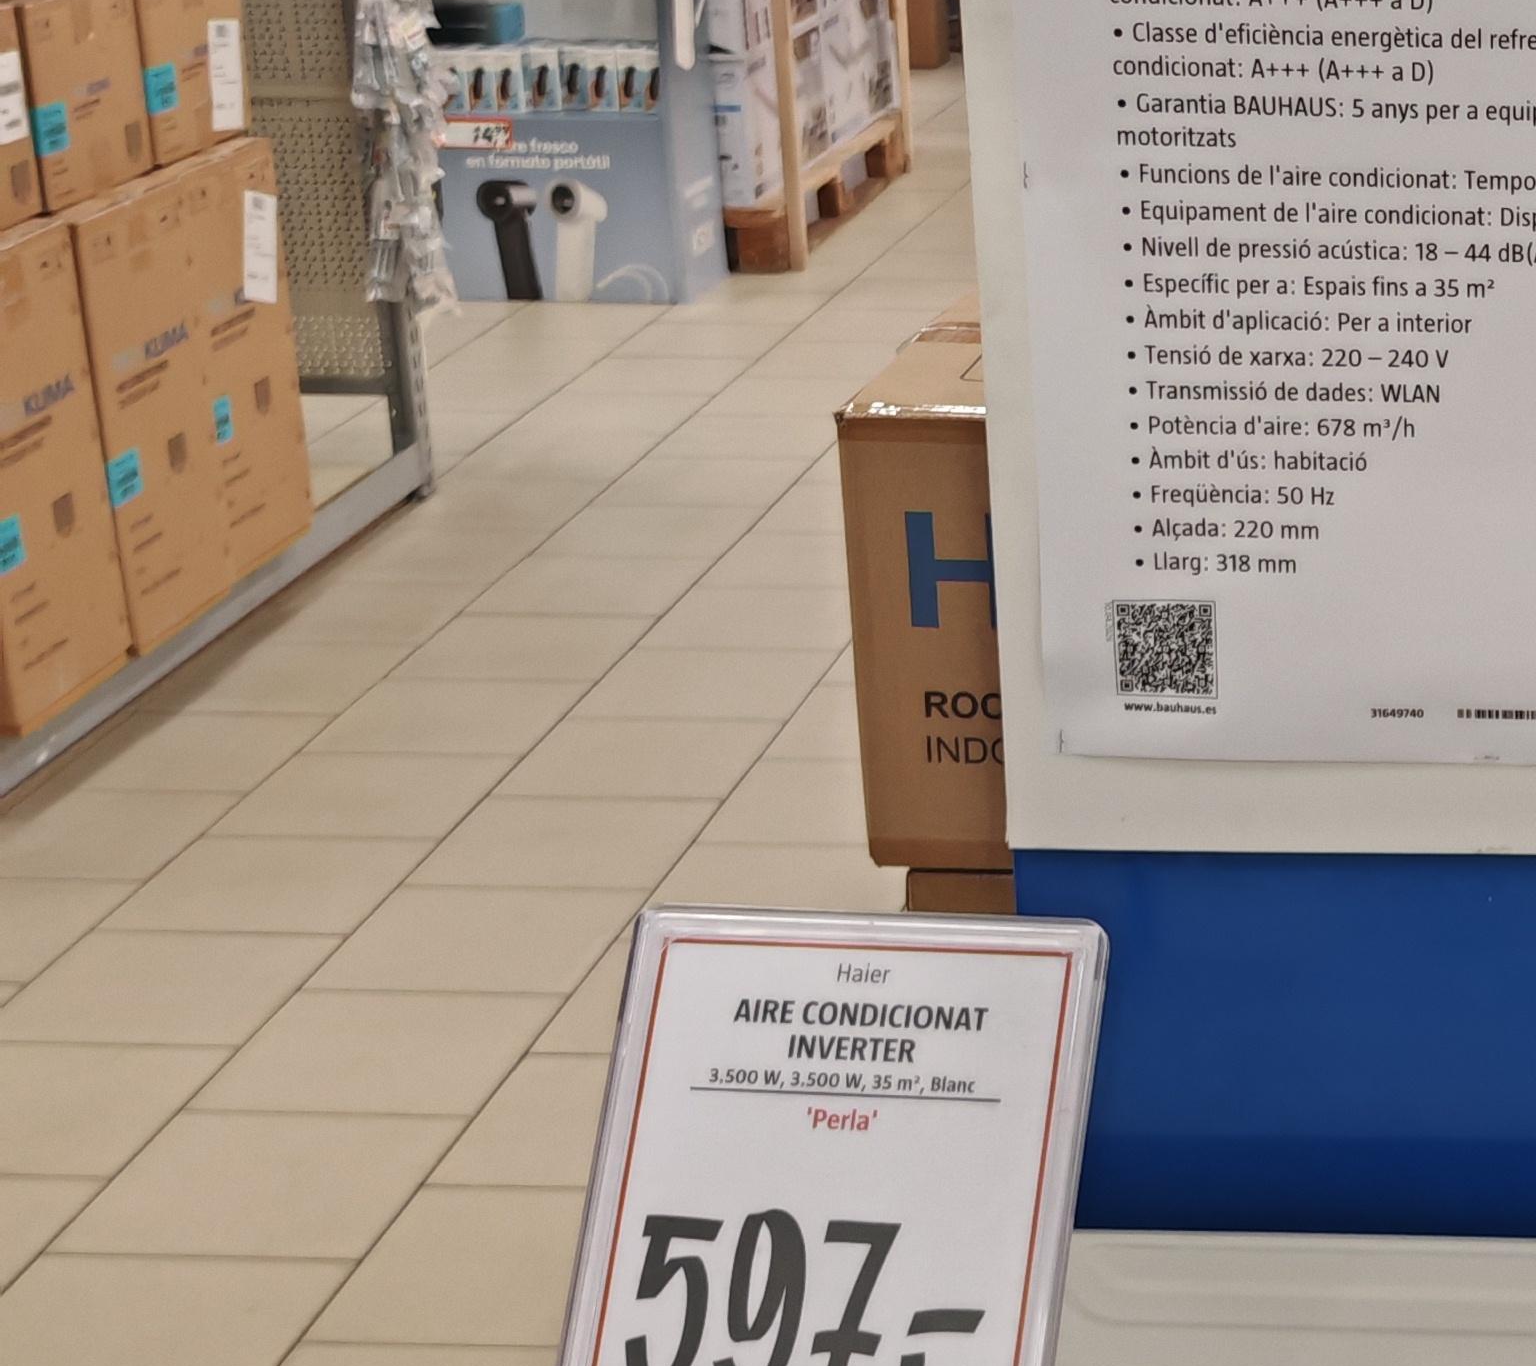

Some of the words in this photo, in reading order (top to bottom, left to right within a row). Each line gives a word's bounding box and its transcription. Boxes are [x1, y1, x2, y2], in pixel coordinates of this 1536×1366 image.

[1132, 20, 1198, 44] Classe
[1204, 21, 1324, 47] d'eficiència
[1330, 25, 1444, 53] energètica
[1450, 27, 1482, 50] del
[1136, 92, 1226, 115] Garantia
[1233, 94, 1344, 118] BAUHAUS:
[1351, 98, 1365, 119] 5
[1371, 102, 1419, 125] anys
[1425, 103, 1461, 125] per
[1466, 104, 1479, 121] a
[1116, 125, 1237, 149] motoritzats
[1139, 162, 1231, 185] Funcions
[1237, 163, 1263, 186] de
[1269, 164, 1322, 187] l'aire
[1328, 166, 1457, 190] condicionat:
[1141, 235, 1199, 258] Nivell
[1205, 236, 1231, 258] de
[1238, 238, 1312, 264] pressió
[1317, 238, 1408, 261] acústica:
[1414, 242, 1438, 262] 18
[1463, 243, 1492, 263] 44
[1144, 303, 1206, 330] Àmbit
[1212, 308, 1330, 336] d'aplicació:
[1337, 312, 1372, 332] Per
[1377, 316, 1390, 333] a
[1396, 311, 1473, 334] interior
[1145, 379, 1268, 401] Transmissió
[1274, 380, 1299, 402] de
[1305, 381, 1373, 403] dades:
[1380, 383, 1440, 404] WLAN
[1148, 414, 1237, 436] Potència
[1243, 415, 1310, 437] d'aire:
[1316, 418, 1356, 437] 678
[1148, 445, 1211, 470] Àmbit
[1216, 449, 1266, 470] d'ús:
[1273, 449, 1368, 472] habitació
[1150, 483, 1270, 508] Freqüència:
[1276, 485, 1304, 506] 50
[1310, 486, 1335, 506] Hz
[1151, 517, 1226, 542] Alçada:
[1234, 519, 1274, 539] 220
[1280, 524, 1320, 540] mm
[1153, 550, 1209, 576] Llarg:
[1216, 553, 1251, 573] 318
[1257, 557, 1297, 574] mm
[1123, 701, 1217, 715] www.bauhaus.es
[1370, 707, 1425, 719] 31649740
[836, 962, 891, 984] Haier
[733, 998, 796, 1025] AIRE
[802, 1000, 989, 1031] CONDICIONAT
[787, 1034, 916, 1063] INVERTER
[709, 1067, 758, 1085] 3.500
[764, 1069, 785, 1089] W,
[790, 1071, 840, 1088] 3.500
[845, 1073, 866, 1092] W,
[872, 1074, 893, 1091] 35
[930, 1075, 975, 1094] Blanc
[806, 1105, 879, 1132] 'Perla'
